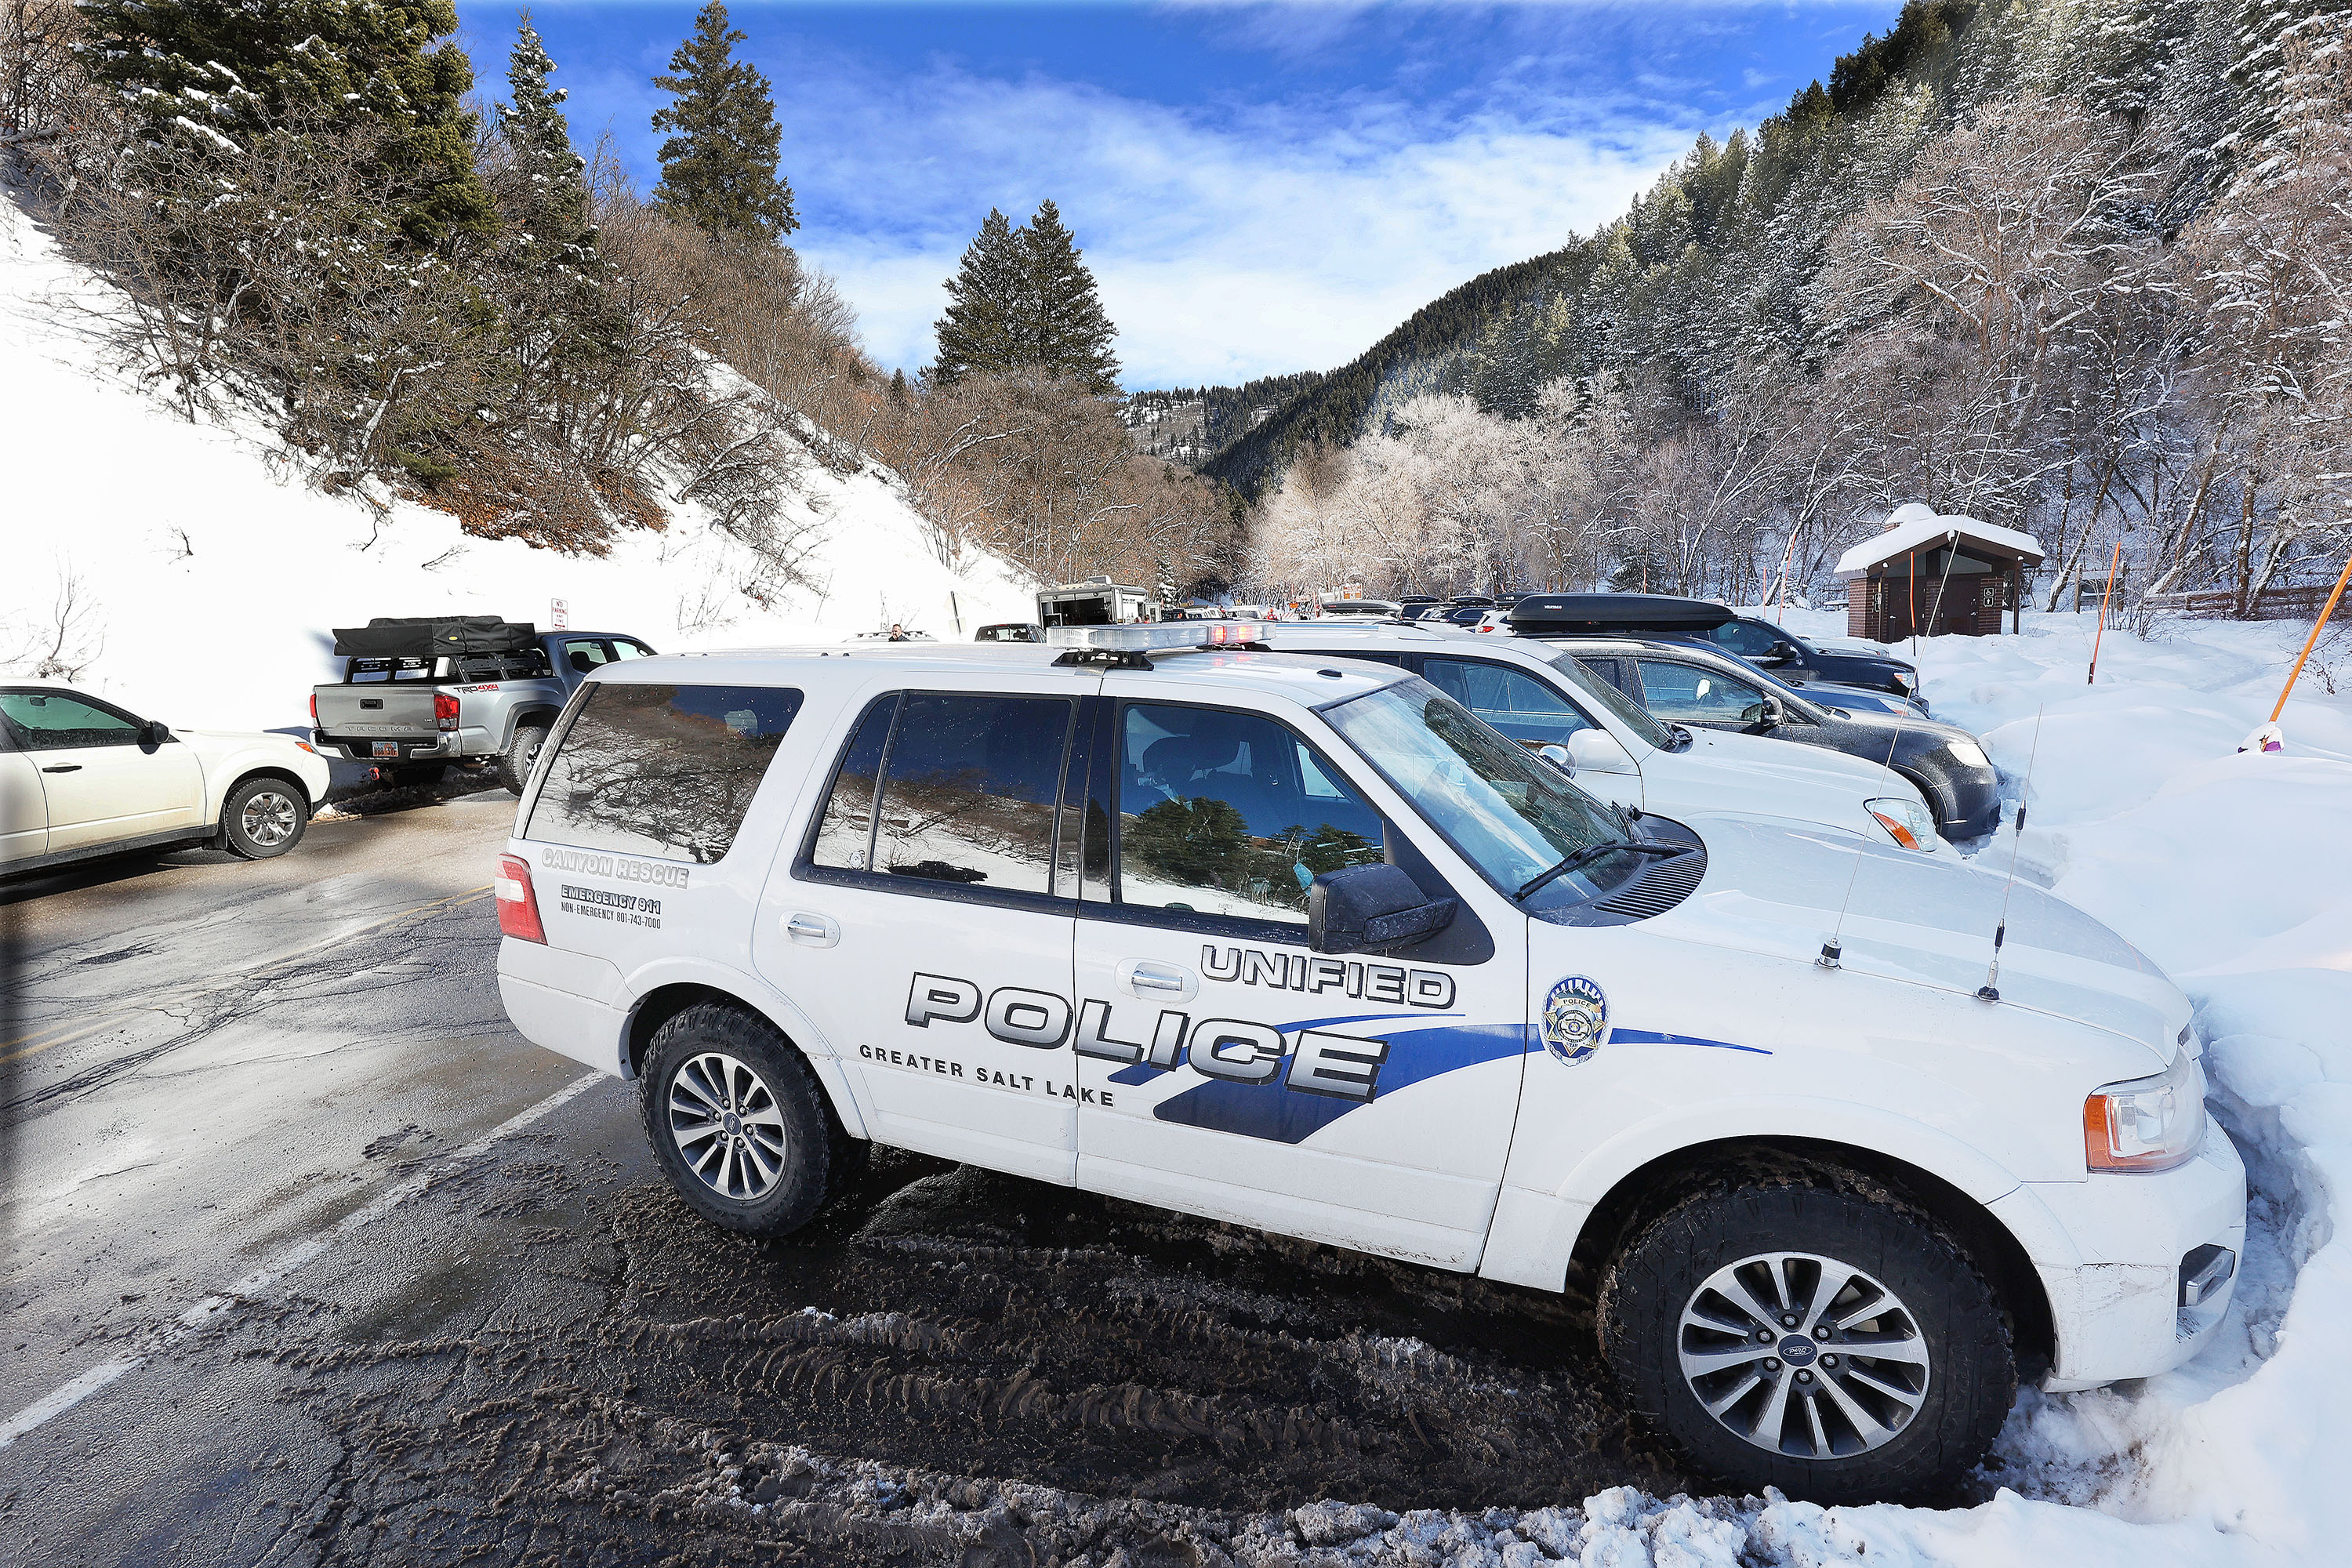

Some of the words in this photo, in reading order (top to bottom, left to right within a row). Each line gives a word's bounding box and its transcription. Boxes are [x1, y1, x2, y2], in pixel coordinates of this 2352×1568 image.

[541, 848, 613, 877] CANYON
[616, 858, 690, 889] RESCUE
[561, 884, 637, 909] EMERGENCY
[638, 898, 661, 915] 911
[561, 902, 614, 921] NON-EMERGENCY
[616, 913, 661, 930] 801-743-7000
[1200, 944, 1457, 1010] UNIFIED
[1563, 999, 1592, 1008] POLICE
[904, 971, 1392, 1104] POLICE
[859, 1044, 964, 1076] GREATER
[976, 1067, 1034, 1091] SALT
[1046, 1079, 1115, 1108] LAKE
